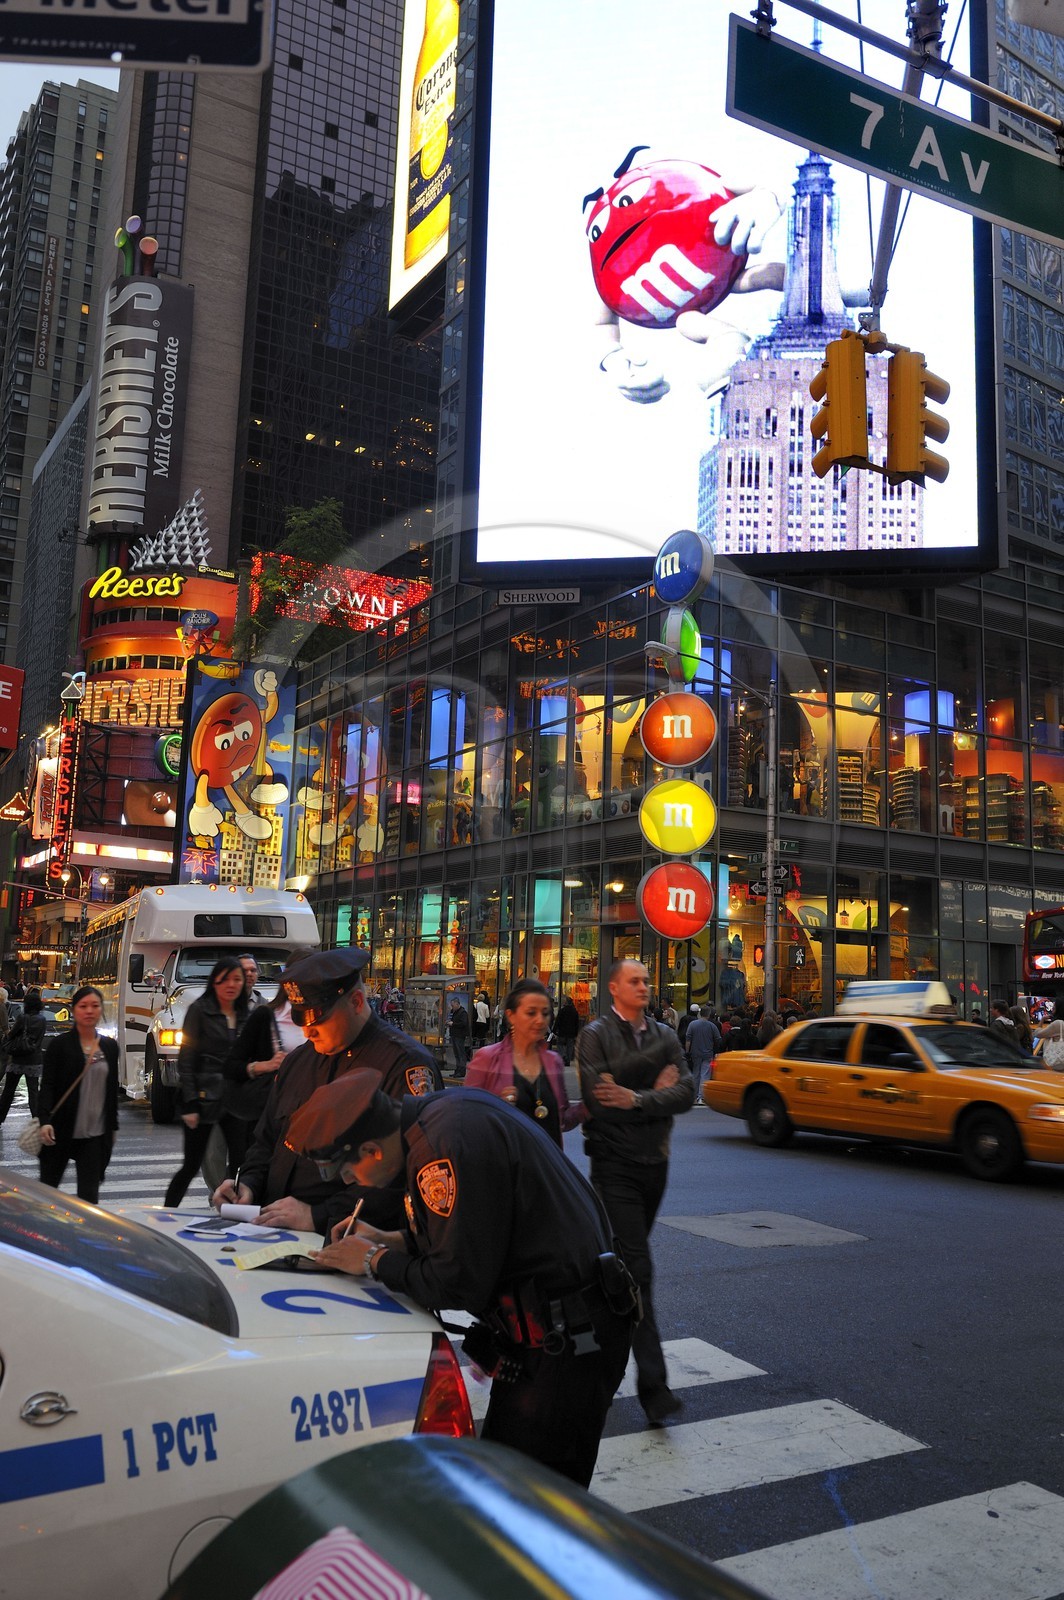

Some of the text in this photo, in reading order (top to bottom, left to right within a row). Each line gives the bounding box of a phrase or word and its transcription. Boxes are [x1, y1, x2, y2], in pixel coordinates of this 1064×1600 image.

[849, 91, 885, 151] 7
[47, 237, 57, 277] RENTAL
[44, 279, 53, 306] APTS
[620, 243, 717, 323] m
[87, 281, 164, 528] HERSHEY'S
[152, 335, 180, 479] Milk Chocolate
[88, 566, 185, 599] Reese's
[660, 551, 681, 580] m
[281, 578, 404, 617] ROWNE
[502, 592, 575, 604] SHERWOOD
[662, 714, 693, 739] m
[50, 717, 76, 880] HERSHEY'S
[663, 802, 694, 828] m
[666, 886, 696, 914] m
[291, 1387, 365, 1443] 2487
[122, 1412, 218, 1479] 1 PCT
